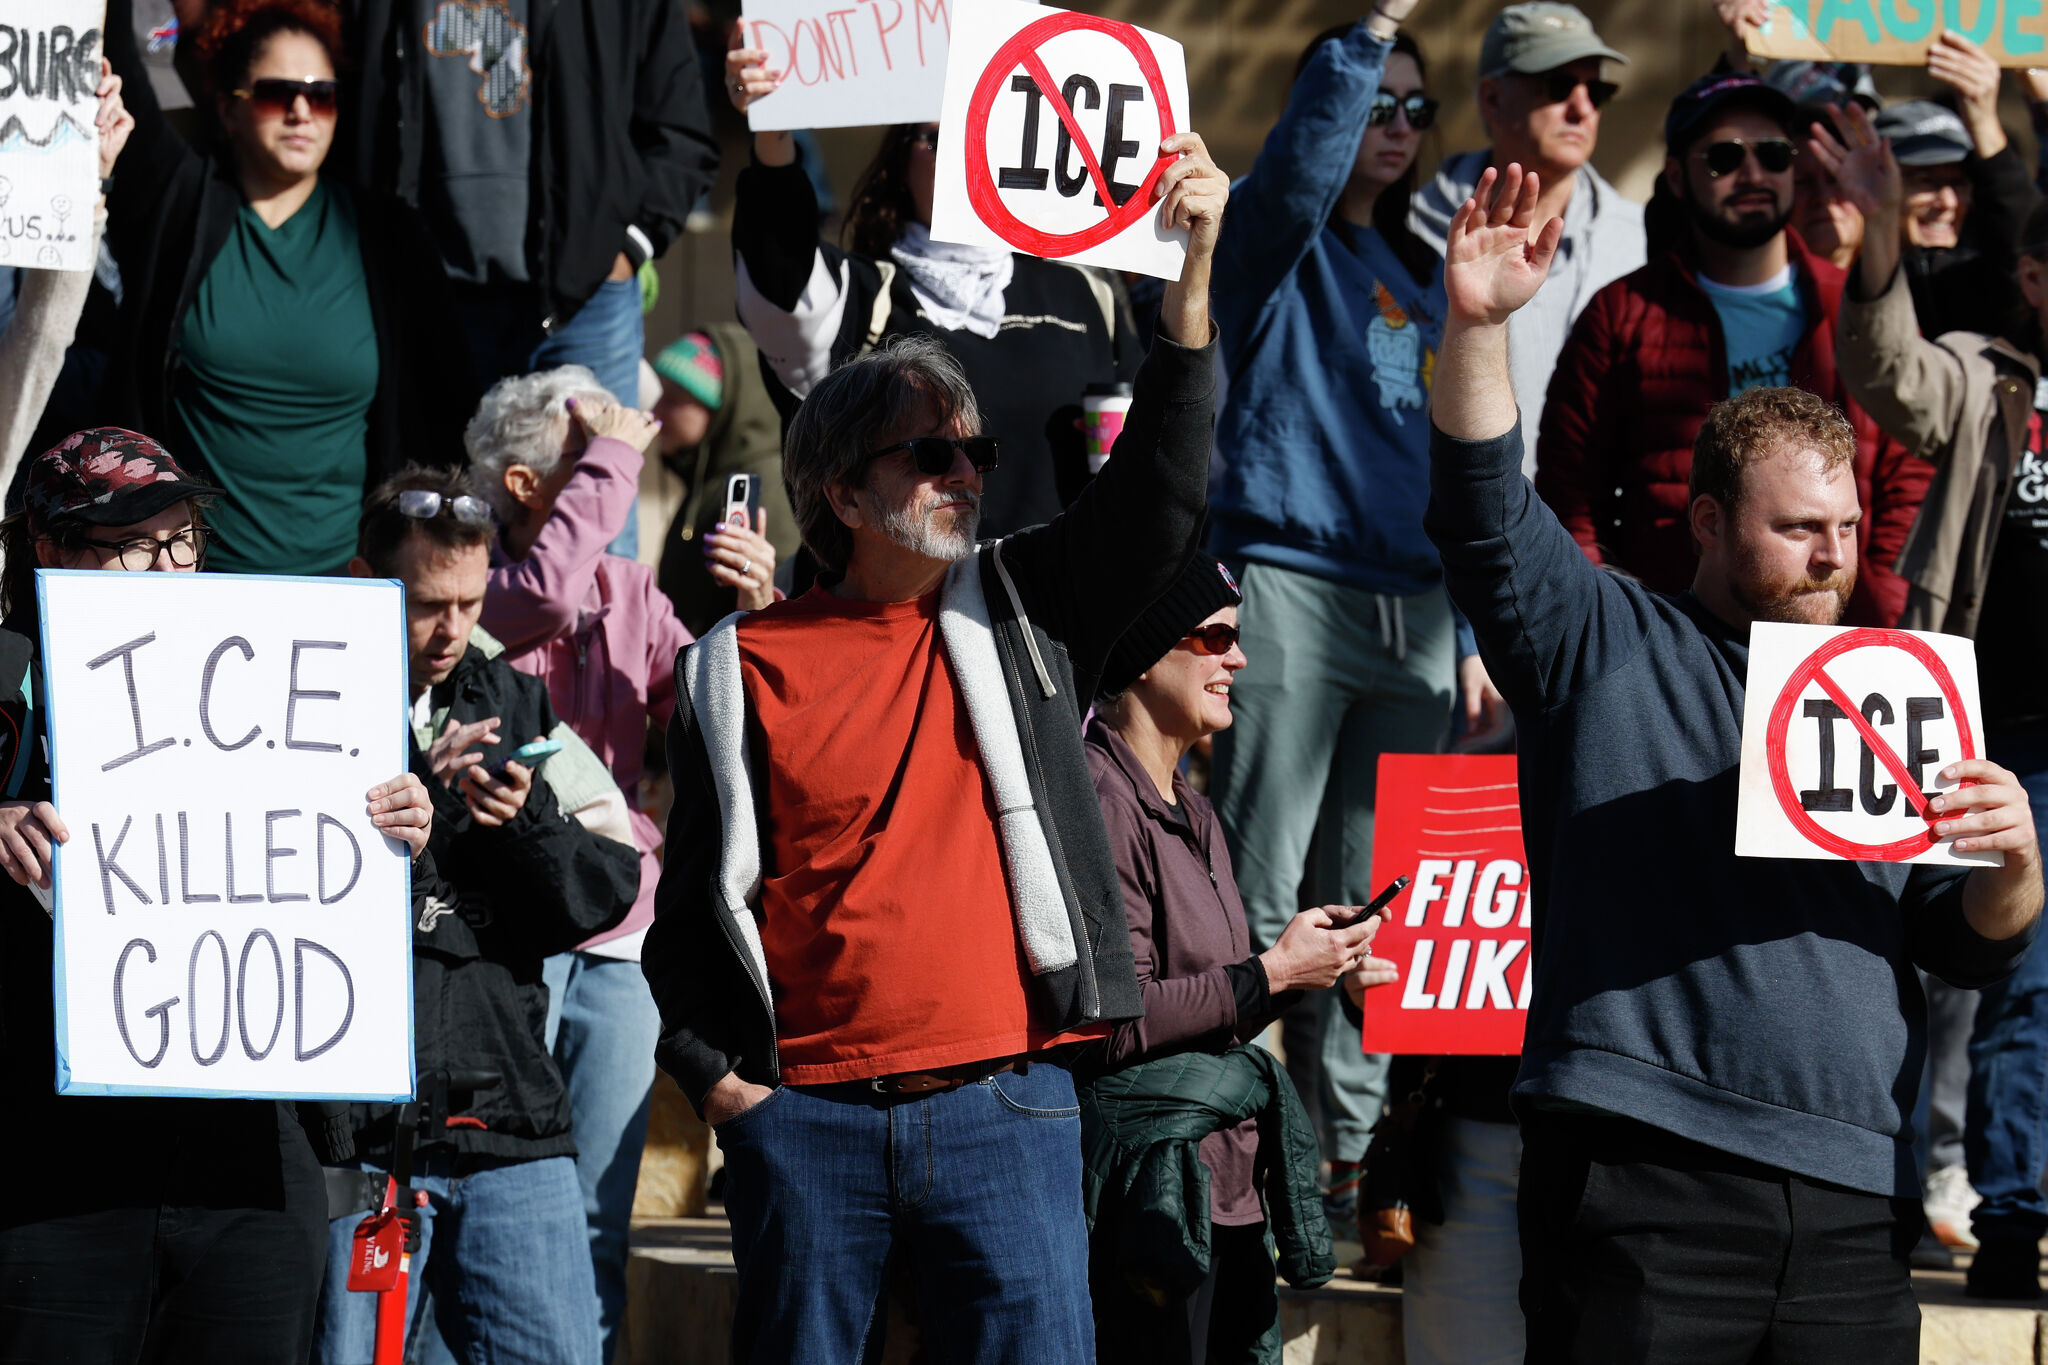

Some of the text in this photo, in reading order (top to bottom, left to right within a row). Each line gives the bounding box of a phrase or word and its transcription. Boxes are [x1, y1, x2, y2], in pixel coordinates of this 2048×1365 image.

[998, 74, 1144, 207] ICE
[86, 630, 360, 773] I.C.E.
[1800, 692, 1945, 818] ICE
[91, 808, 363, 916] KILLED
[113, 927, 355, 1069] GOOD
[361, 1235, 376, 1275] VIKING
